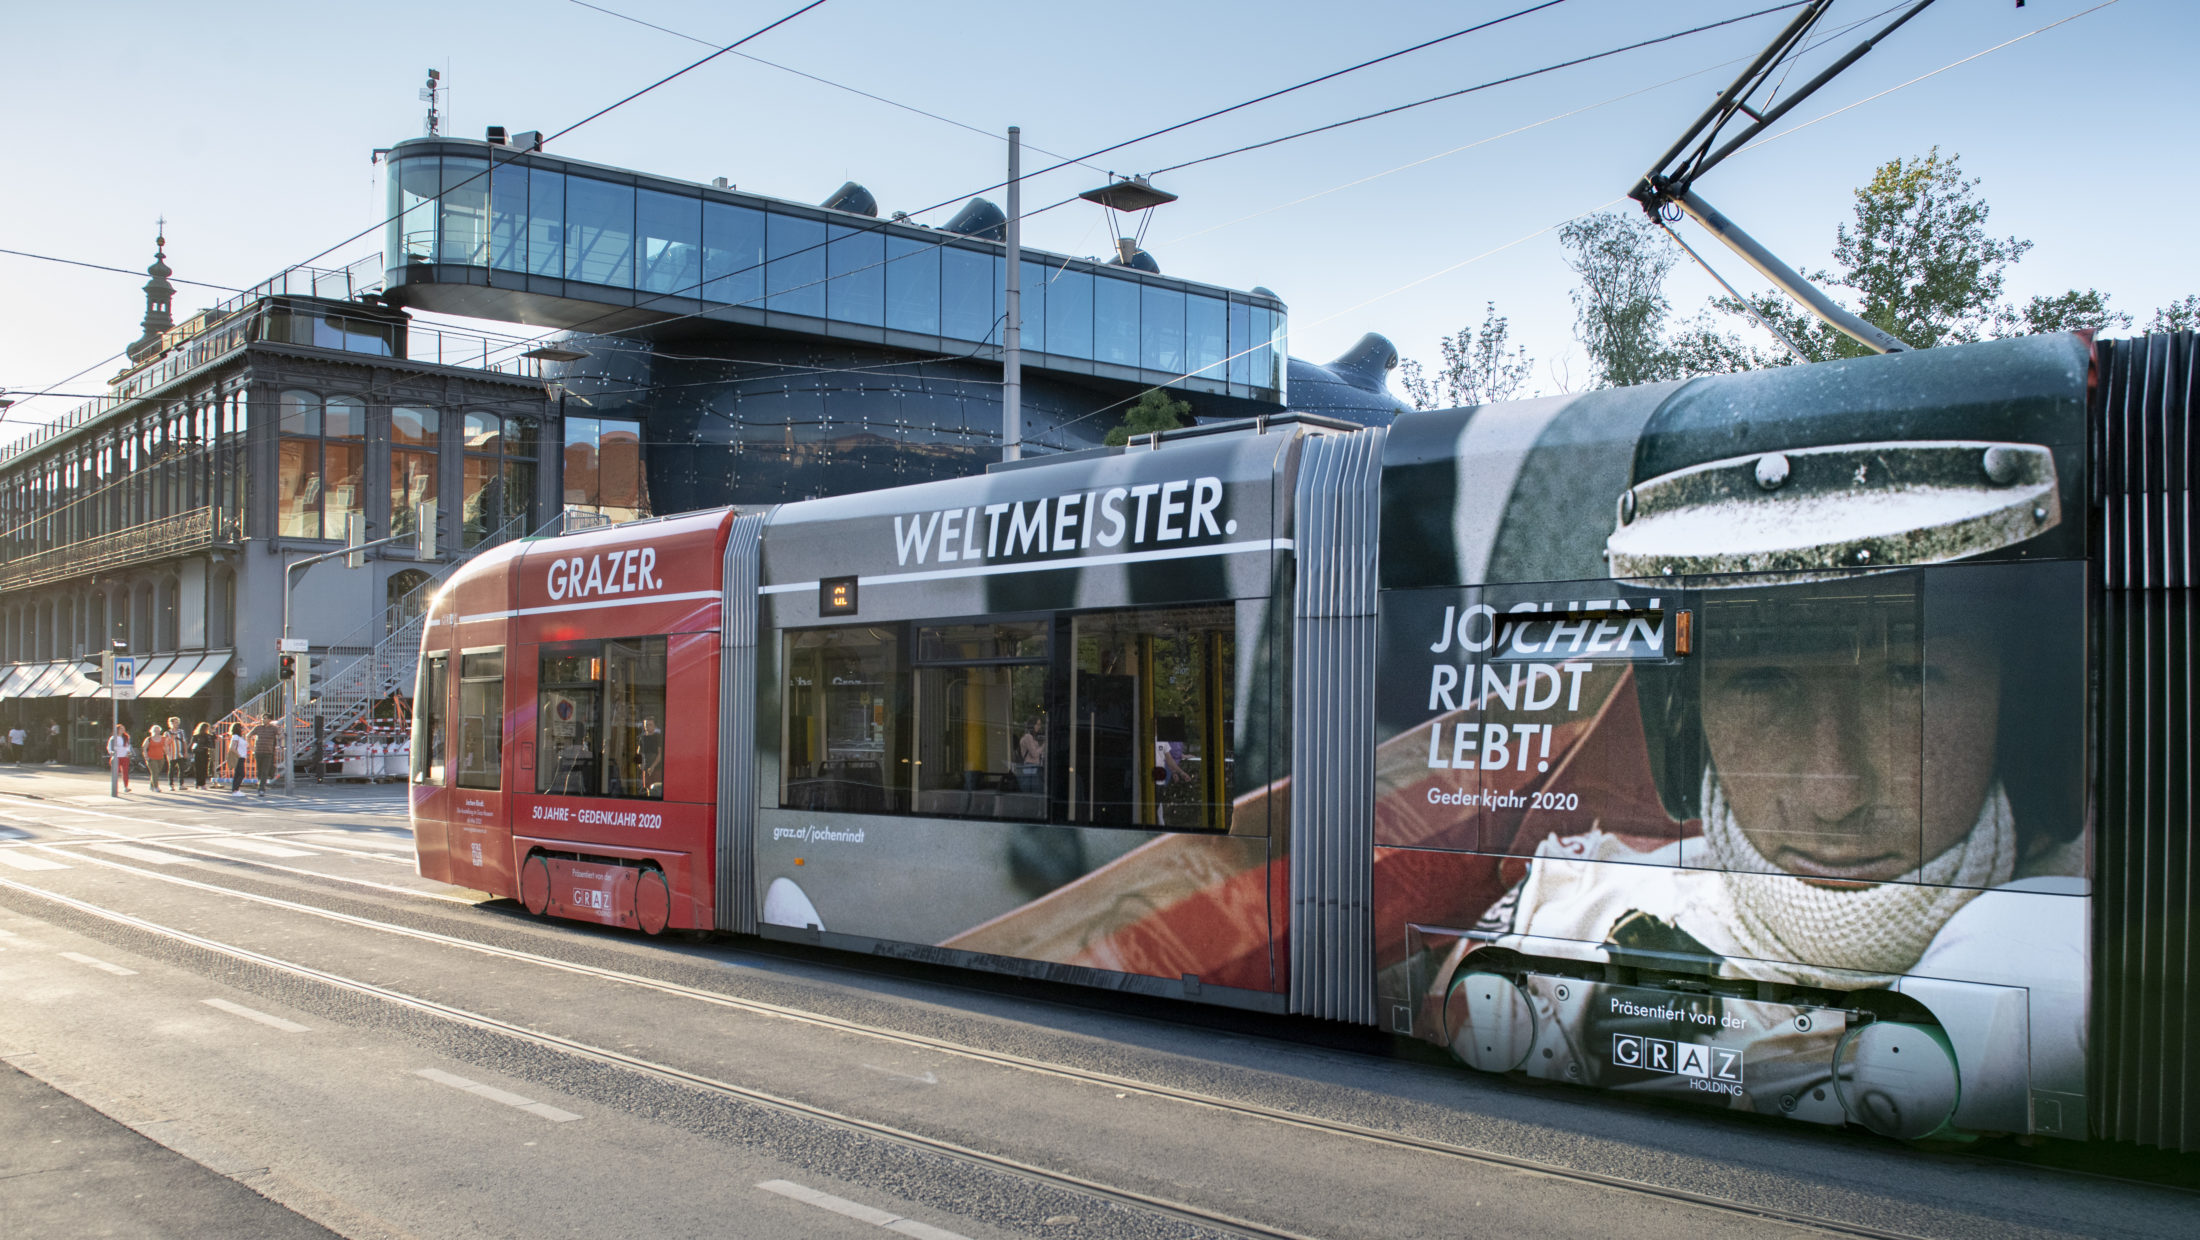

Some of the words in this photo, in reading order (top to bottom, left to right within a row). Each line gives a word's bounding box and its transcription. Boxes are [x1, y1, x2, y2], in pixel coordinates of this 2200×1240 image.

[893, 476, 1238, 566] WELTMEISTER.
[547, 547, 663, 600] GRAZER.
[1430, 598, 1664, 654] JOCHEN
[1428, 661, 1593, 712] RINDT
[1428, 722, 1553, 773] LEBT!
[532, 805, 543, 820] 50
[543, 807, 569, 822] JAHRE
[577, 809, 637, 827] GEDENKJAHR
[638, 813, 662, 829] 2020
[1427, 787, 1527, 812] Gedenkjahr
[1530, 791, 1579, 811] 2020
[773, 824, 865, 844] graz.at/jochenrindt
[574, 889, 610, 909] GRAZ
[1611, 998, 1685, 1022] Präsentiert
[1688, 1011, 1716, 1026] von
[1720, 1011, 1747, 1029] der
[1614, 1035, 1741, 1082] GRAZ
[1689, 1078, 1743, 1096] HOLDING
